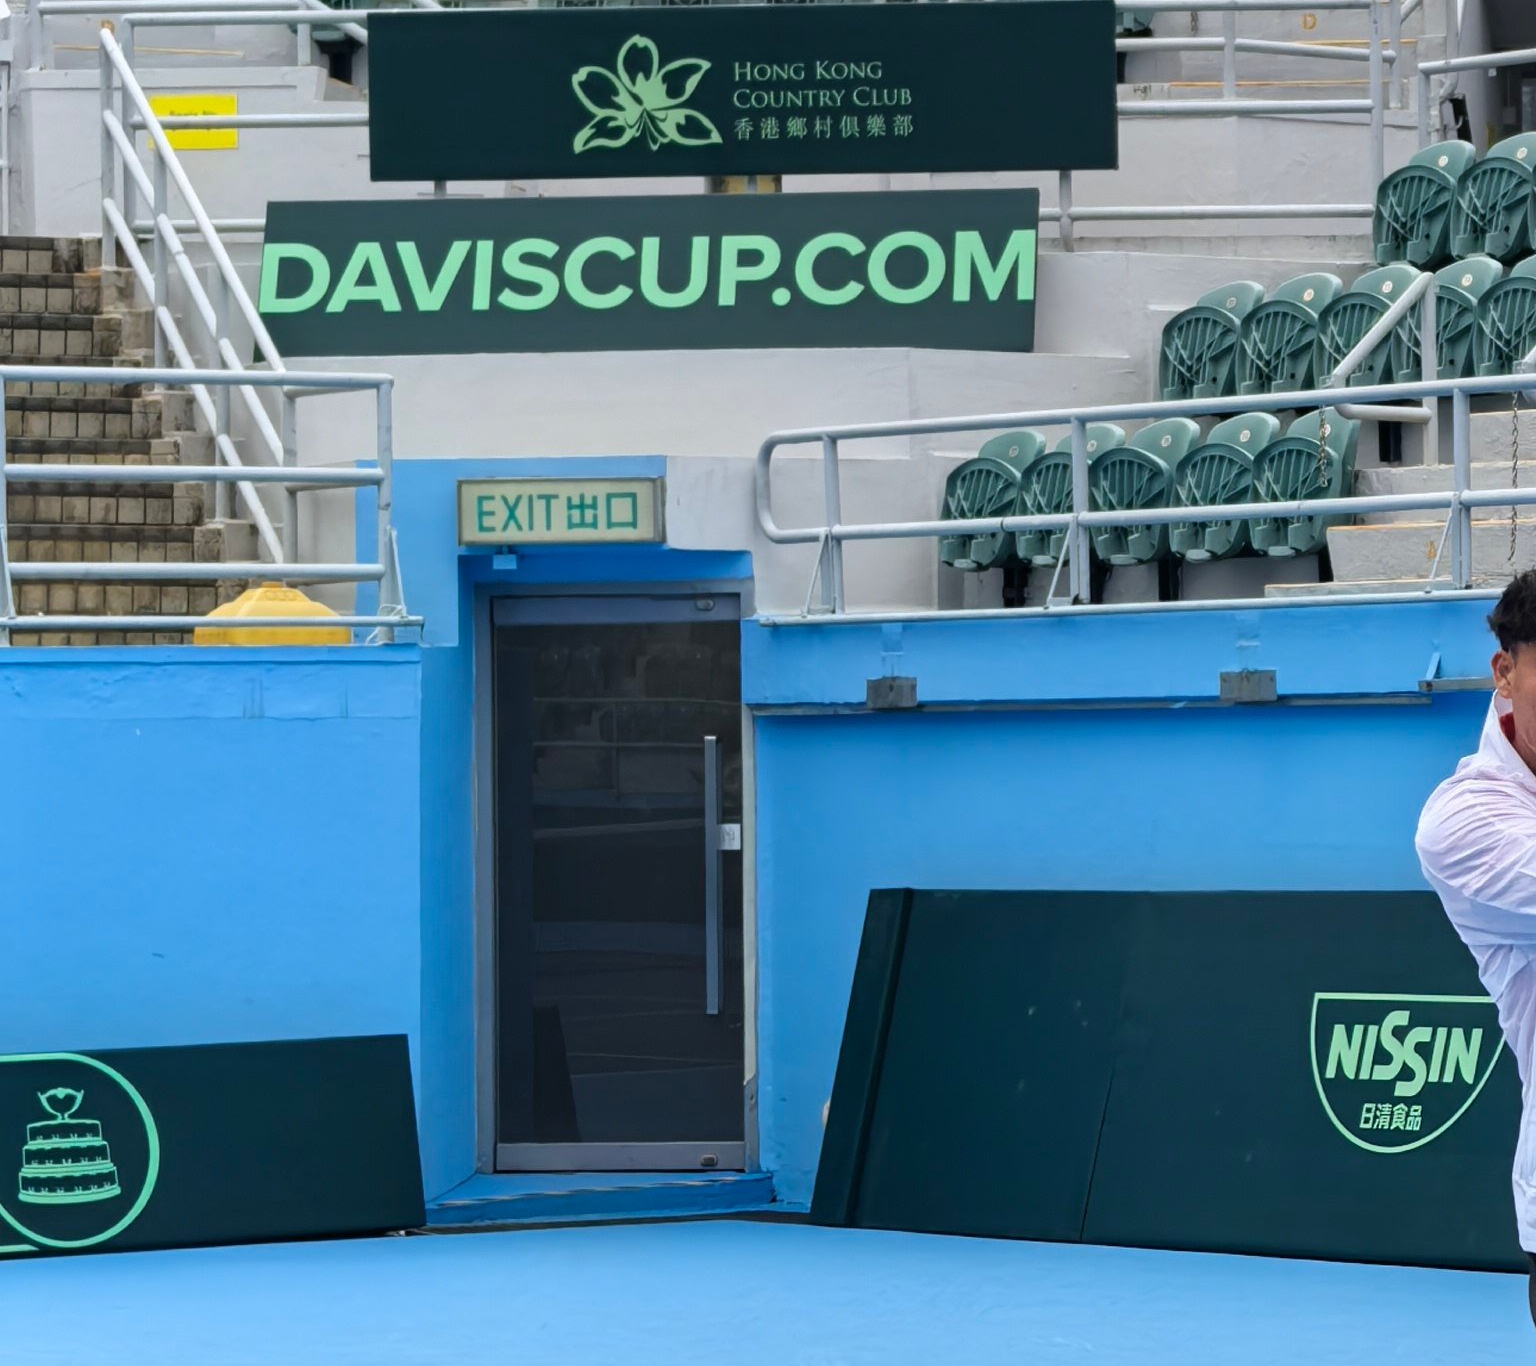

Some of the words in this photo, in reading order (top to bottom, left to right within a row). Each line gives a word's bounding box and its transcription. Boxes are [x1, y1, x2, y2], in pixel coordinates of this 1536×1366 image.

[733, 61, 806, 82] HONG
[815, 60, 883, 80] KONG
[733, 88, 846, 109] COUNTRY
[852, 86, 912, 107] CLUB
[733, 114, 914, 141] 香港鄉村俱樂部
[258, 228, 1037, 315] DAVISCUP.COM
[476, 493, 560, 533] EXIT
[566, 492, 638, 531] 出口
[1325, 1009, 1483, 1097] NISSIN
[1358, 1102, 1422, 1131] 日清食品
